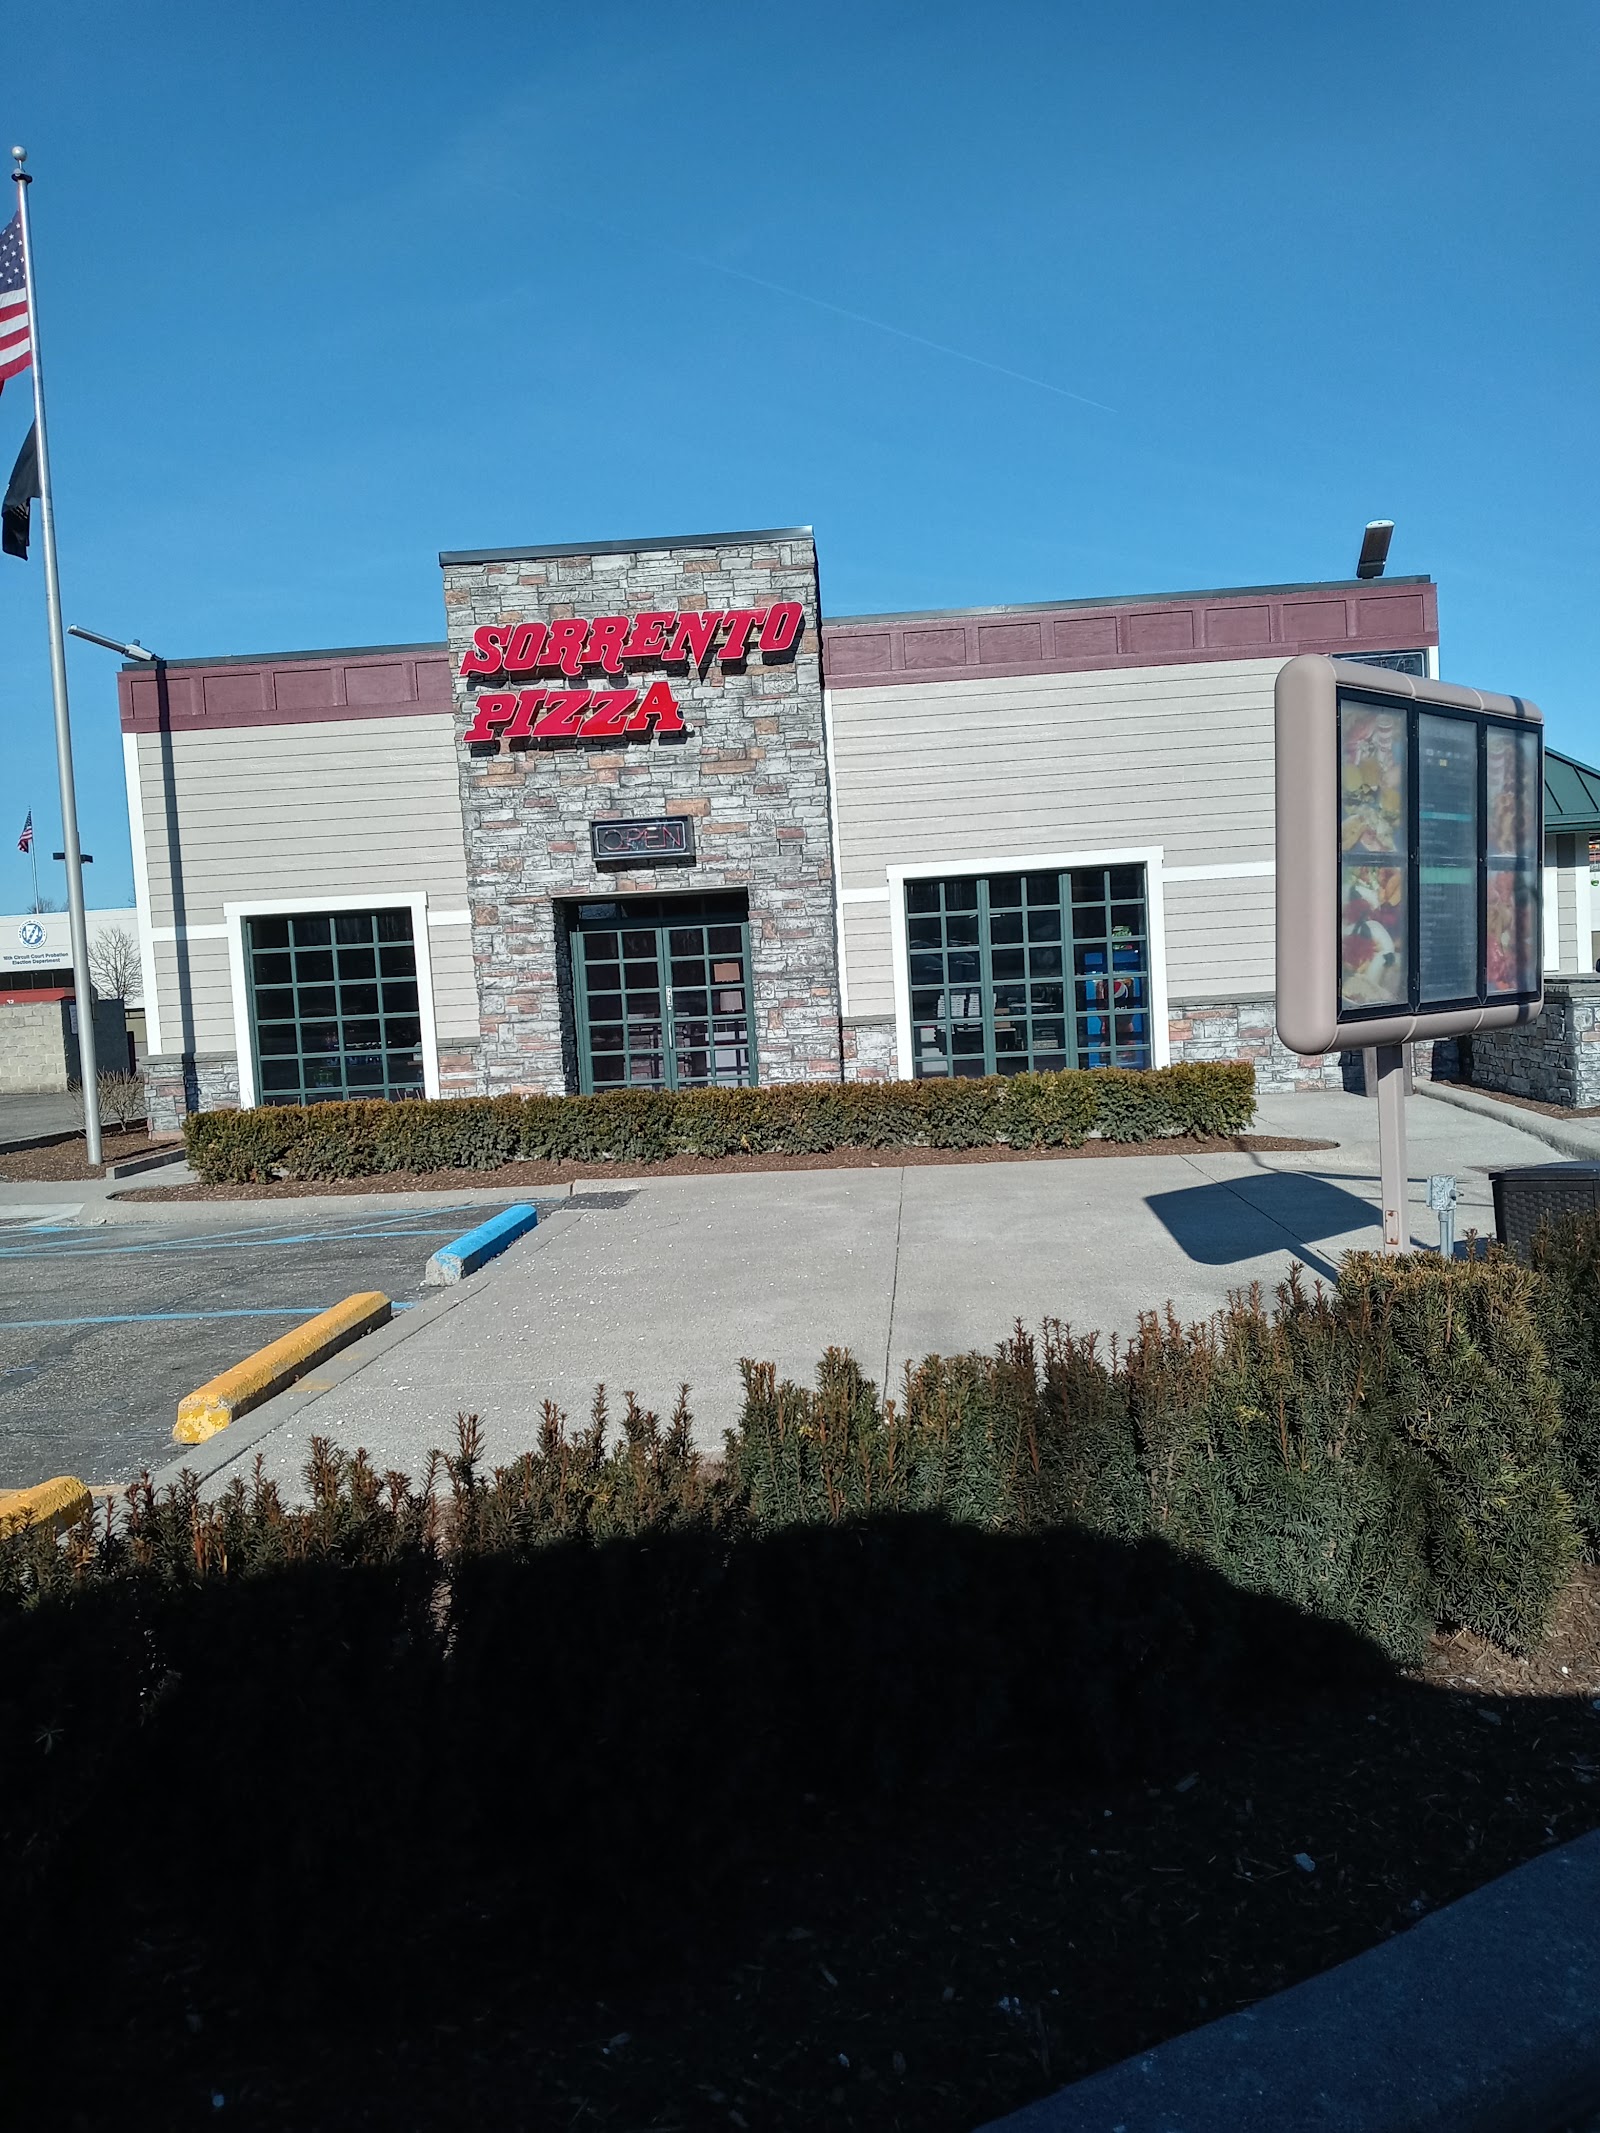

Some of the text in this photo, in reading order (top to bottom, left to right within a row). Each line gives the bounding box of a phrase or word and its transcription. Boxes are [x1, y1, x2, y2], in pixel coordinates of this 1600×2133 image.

[459, 601, 803, 676] SORRENTO
[463, 681, 685, 742] PIZZA
[603, 825, 681, 851] OPEN
